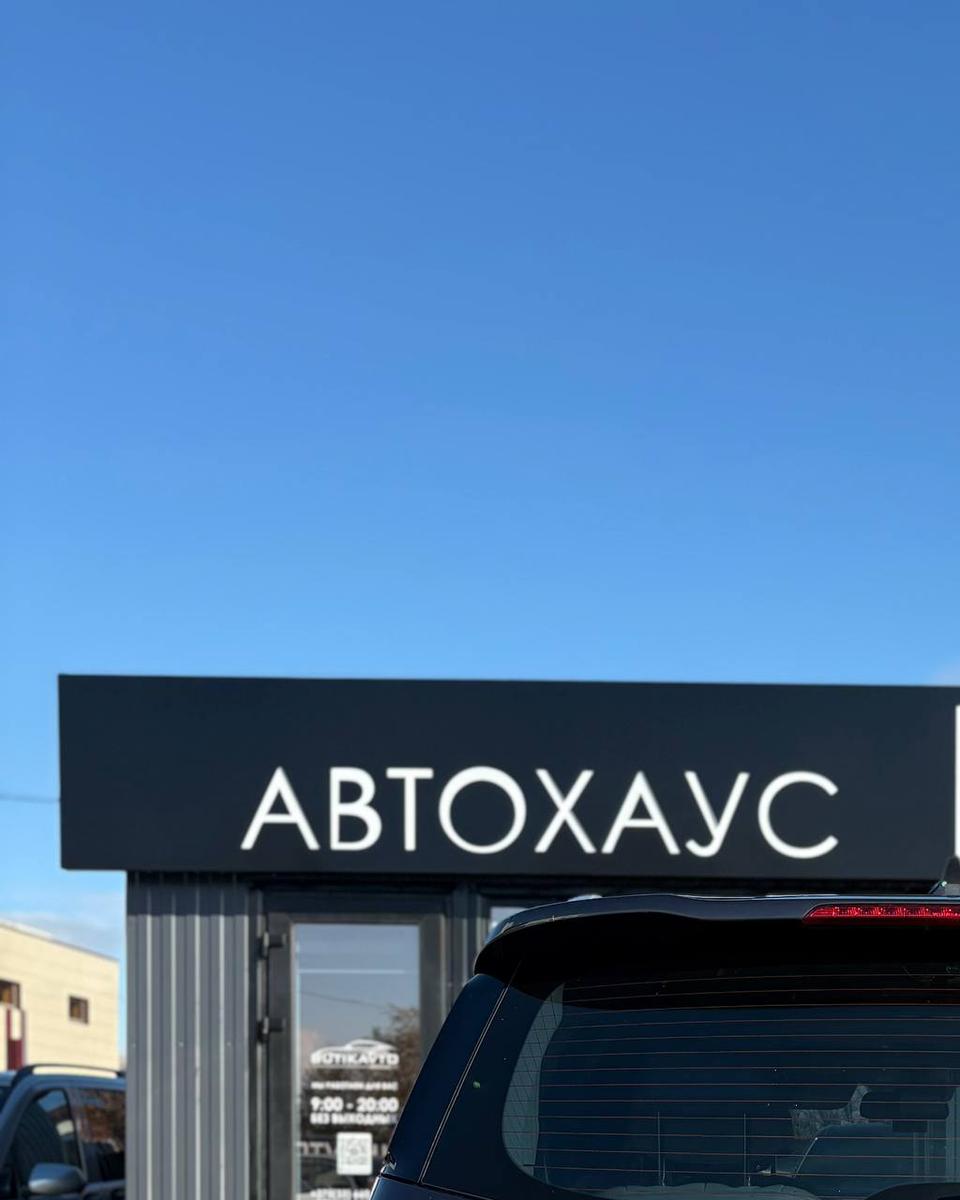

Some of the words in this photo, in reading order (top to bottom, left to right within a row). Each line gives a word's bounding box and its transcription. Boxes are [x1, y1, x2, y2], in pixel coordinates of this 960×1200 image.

[240, 766, 839, 859] АВТОХАУС
[310, 1096, 343, 1113] 9:00
[356, 1097, 399, 1113] 20:00
